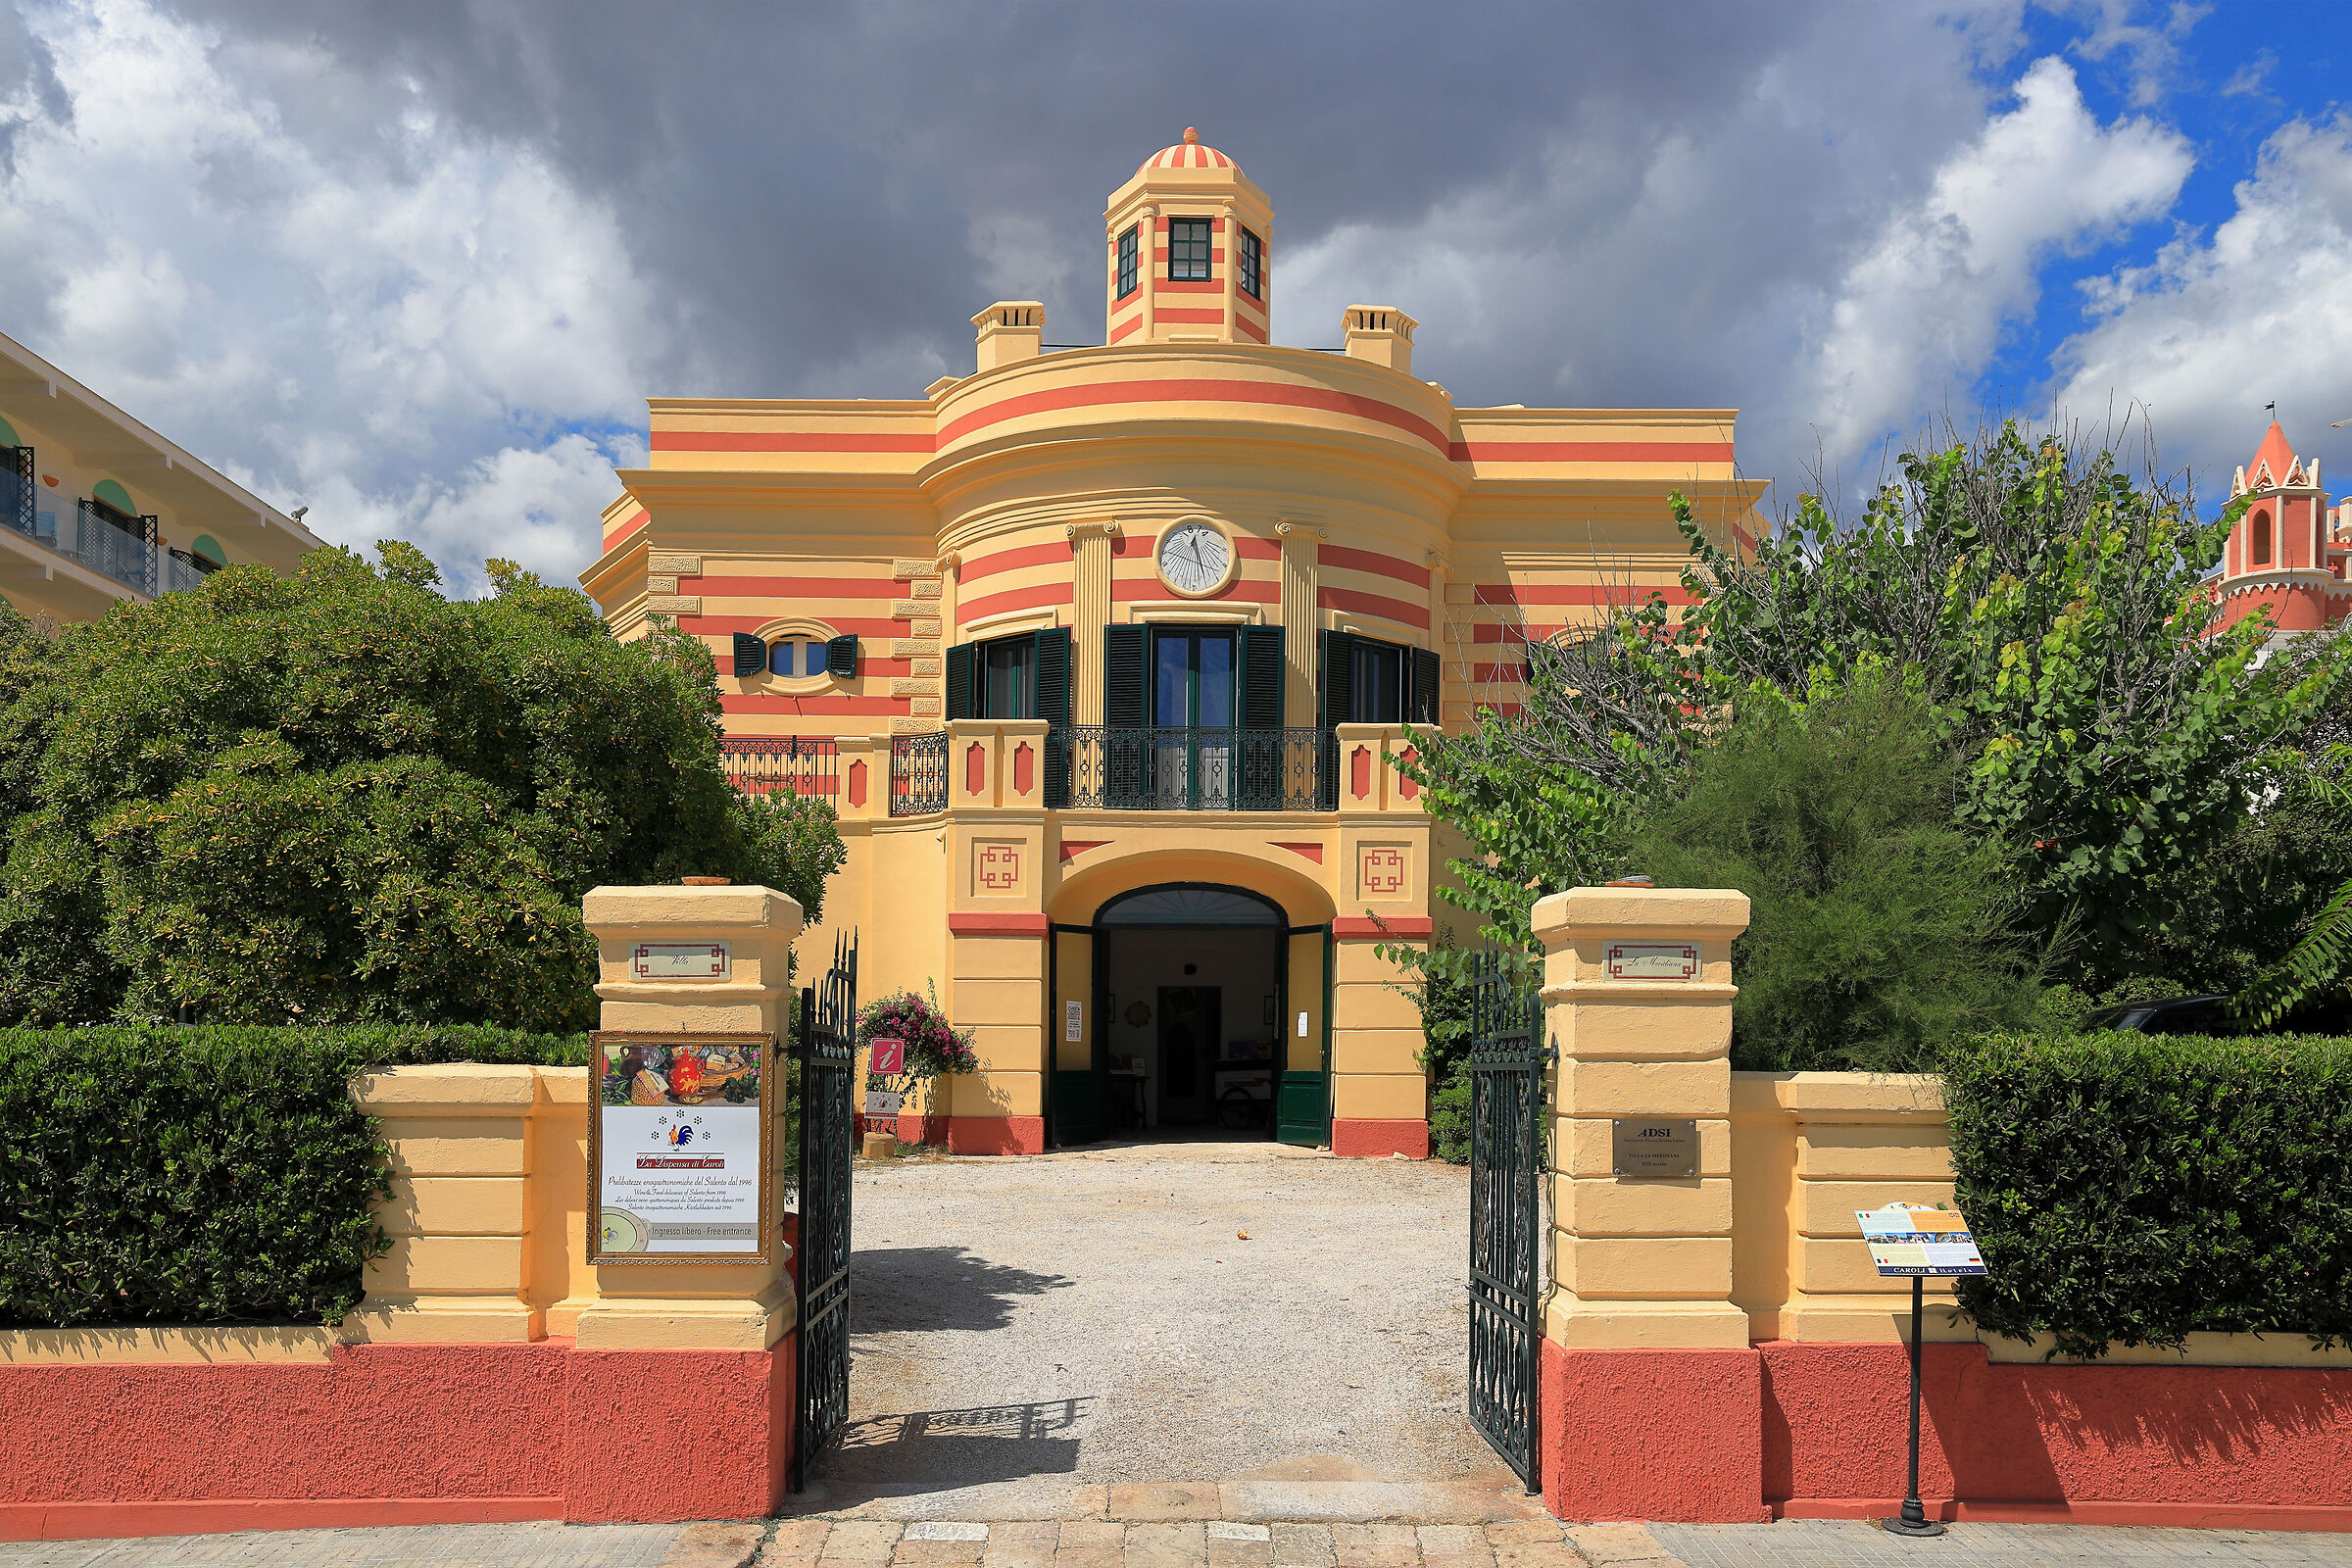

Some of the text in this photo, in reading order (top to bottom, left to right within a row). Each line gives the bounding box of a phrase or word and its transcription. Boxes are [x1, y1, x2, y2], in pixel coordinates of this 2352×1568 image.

[671, 955, 689, 965] Villa
[1627, 956, 1682, 967] La Meridiana
[1638, 1128, 1671, 1138] ADSI
[637, 1154, 725, 1169] La Dispensa di Caroli
[643, 1176, 693, 1188] enogastronomiche
[694, 1176, 704, 1186] del
[704, 1176, 727, 1186] Salento
[727, 1176, 738, 1186] dal
[652, 1227, 681, 1237] Ingresso
[681, 1227, 702, 1236] libero
[707, 1227, 721, 1236] Free
[722, 1227, 752, 1236] entrance
